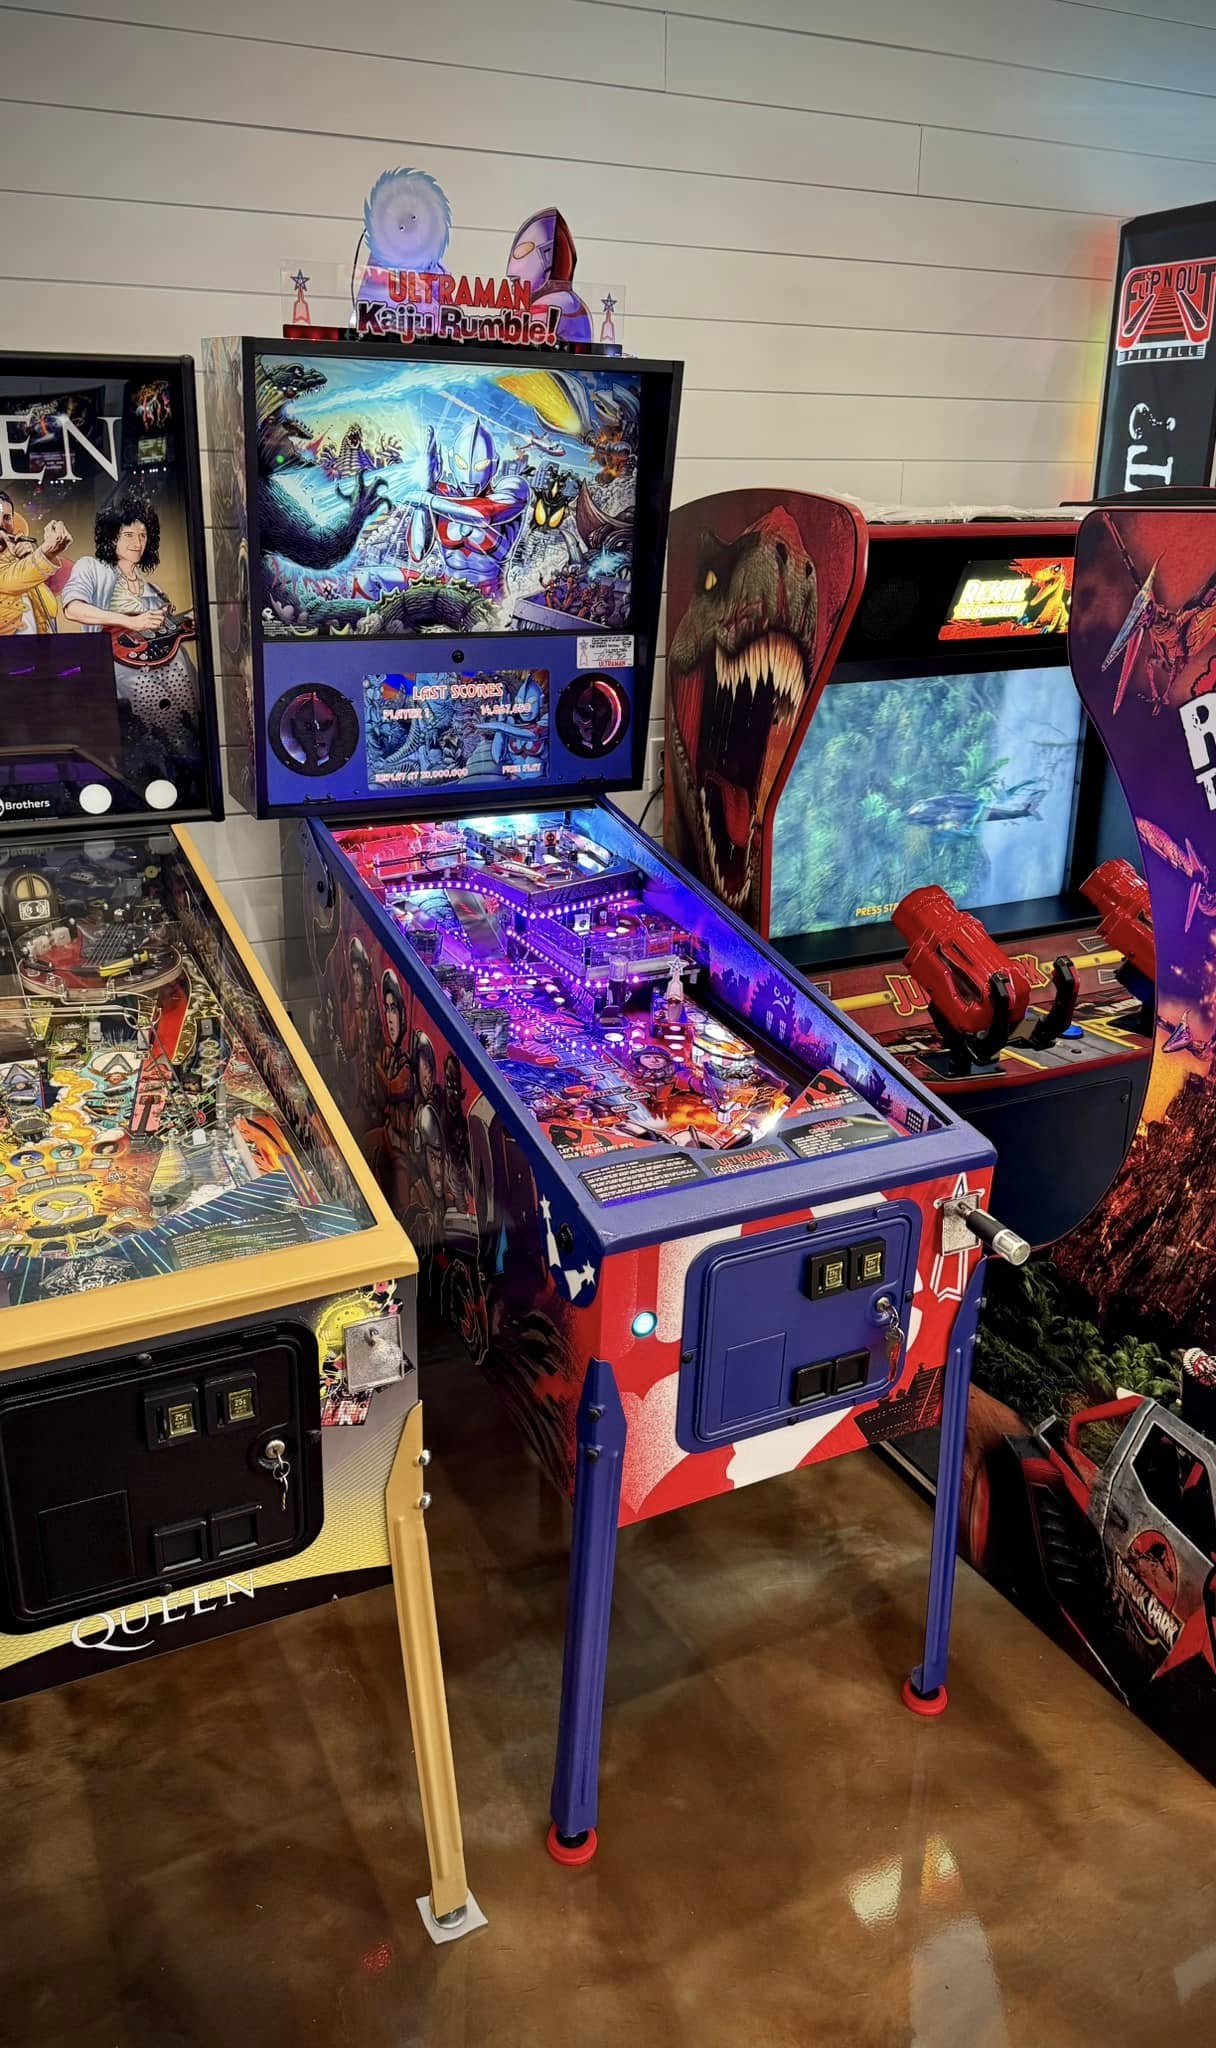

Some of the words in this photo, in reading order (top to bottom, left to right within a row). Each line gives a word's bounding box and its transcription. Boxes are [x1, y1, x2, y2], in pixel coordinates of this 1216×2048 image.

[387, 270, 531, 310] ULTRAMAN
[356, 300, 434, 344] Kaiju
[438, 304, 563, 345] Rumble!
[412, 684, 448, 701] LAST
[451, 682, 504, 698] SCORES
[383, 708, 423, 721] PLAYER
[5, 799, 51, 811] Brothers
[856, 905, 882, 917] PRESS
[884, 902, 900, 913] STA
[718, 1149, 772, 1167] ULTRAMAN
[70, 1572, 256, 1652] QUEEN
